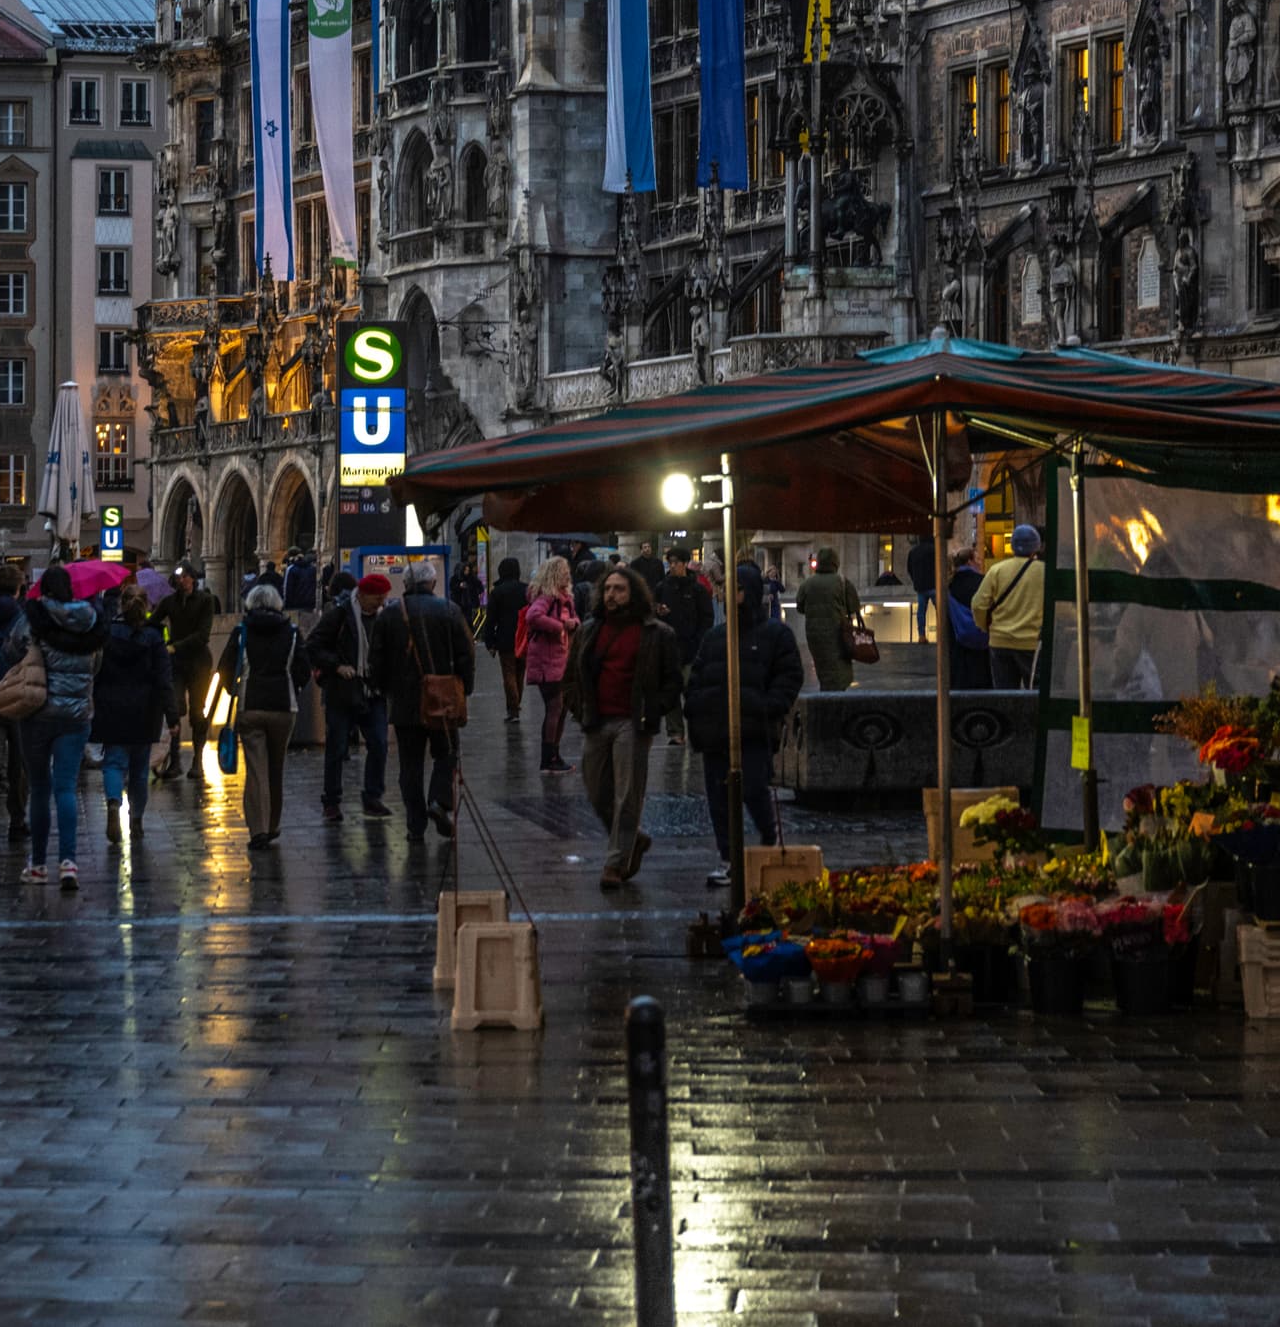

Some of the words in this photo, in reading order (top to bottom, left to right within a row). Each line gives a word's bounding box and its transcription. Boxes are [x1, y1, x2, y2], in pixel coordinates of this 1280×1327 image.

[353, 330, 395, 381] S
[353, 396, 391, 446] U
[342, 466, 405, 478] Marienplatz
[104, 507, 120, 527] S
[104, 529, 119, 549] U
